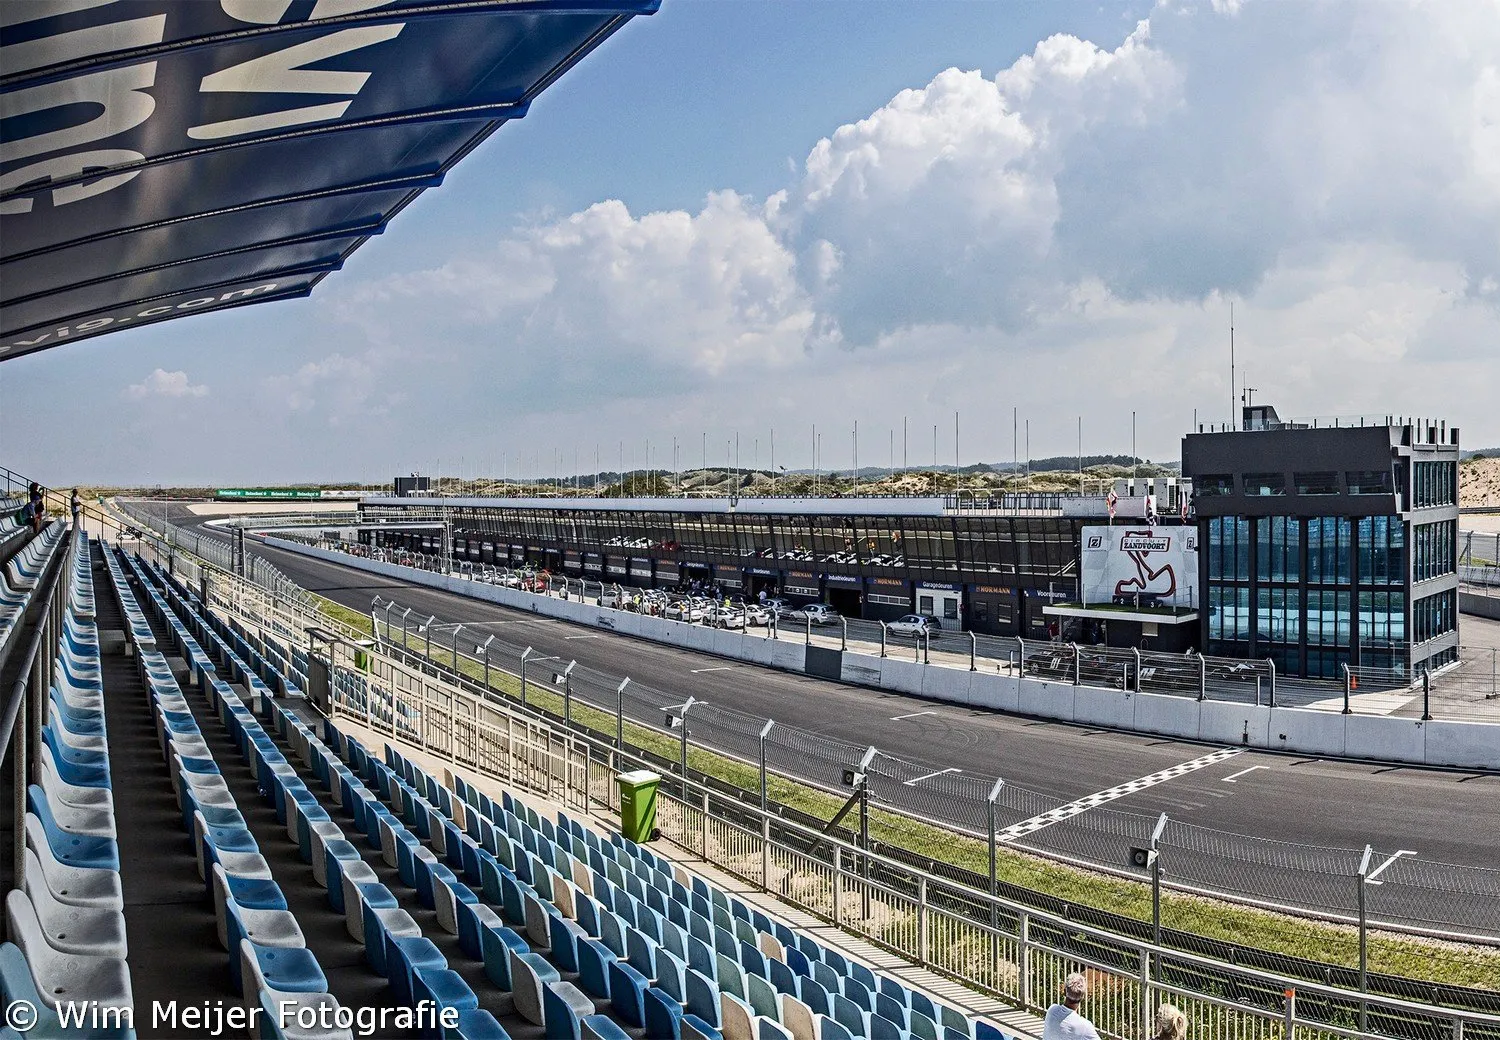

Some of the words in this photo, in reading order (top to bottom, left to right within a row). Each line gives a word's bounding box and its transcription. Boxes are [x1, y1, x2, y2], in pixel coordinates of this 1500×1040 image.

[1124, 542, 1166, 550] ZANDVOORT
[922, 581, 953, 589] Garagedeuren
[1036, 590, 1066, 598] Vooreuren
